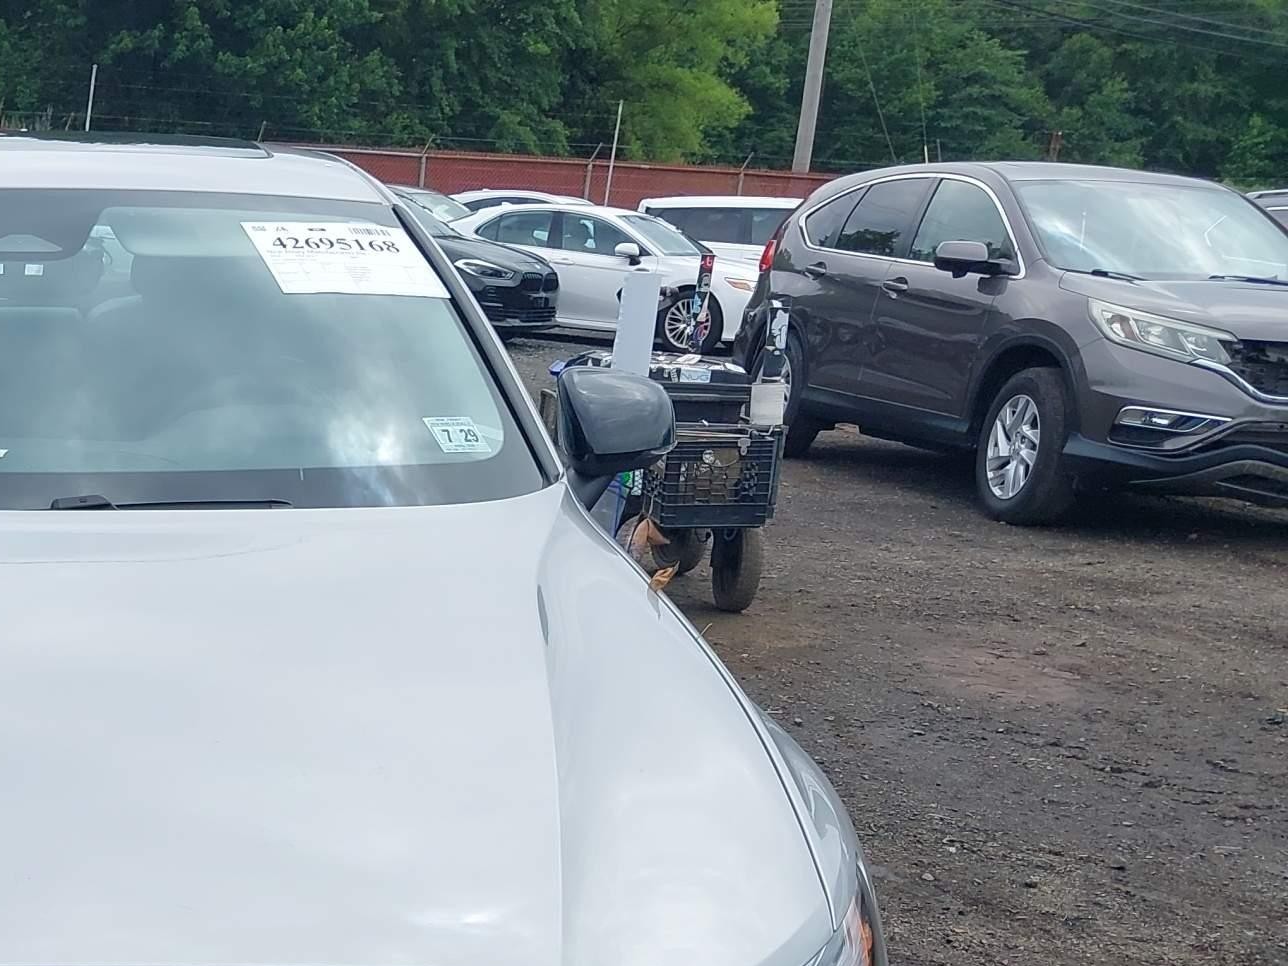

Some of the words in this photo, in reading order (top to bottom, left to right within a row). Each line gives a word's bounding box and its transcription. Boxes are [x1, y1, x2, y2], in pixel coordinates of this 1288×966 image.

[272, 236, 401, 254] 42695168
[440, 428, 453, 443] 7
[459, 428, 479, 443] 29
